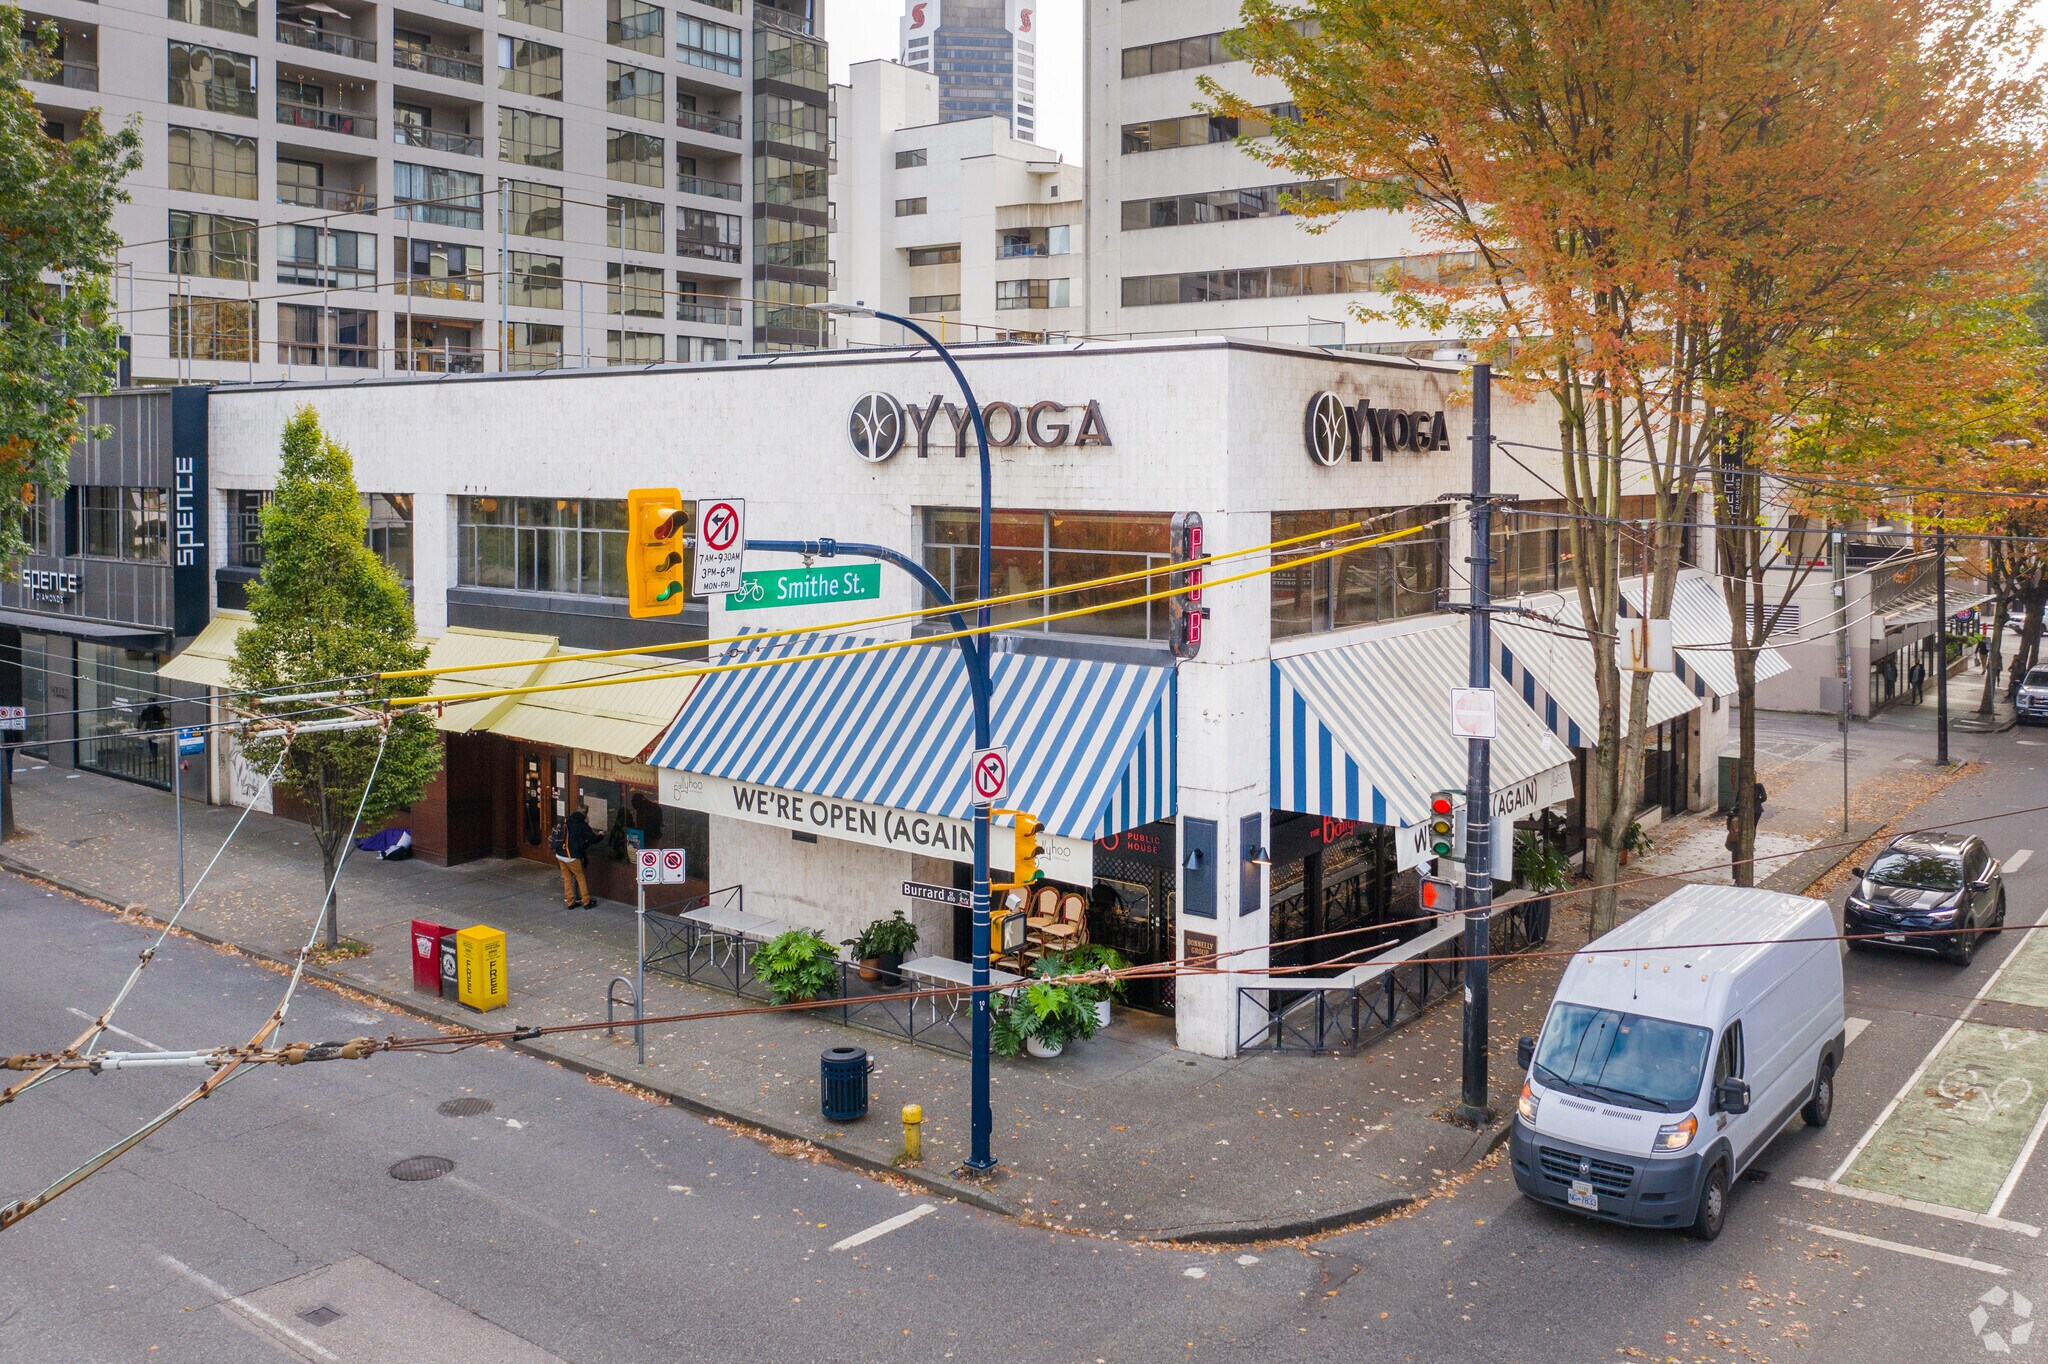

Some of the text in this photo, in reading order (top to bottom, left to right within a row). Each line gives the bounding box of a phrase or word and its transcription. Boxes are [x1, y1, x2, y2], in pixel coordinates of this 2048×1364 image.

[906, 394, 1113, 458] YYOGA
[1344, 399, 1450, 462] YYOGA
[701, 567, 736, 579] 3PM-6PM
[703, 581, 731, 590] MON-FRI
[777, 572, 865, 600] Smithe St.
[1190, 528, 1202, 643] PUB
[1492, 778, 1538, 818] (AGAIN)
[733, 786, 975, 853] WE'RE OPEN (AGAIN
[1127, 832, 1160, 844] PUBLIC
[1127, 842, 1158, 854] HOUSE
[904, 884, 945, 901] Burrard
[1186, 939, 1214, 950] DONNELLY
[1191, 947, 1210, 956] GROUP
[489, 960, 498, 995] FREE
